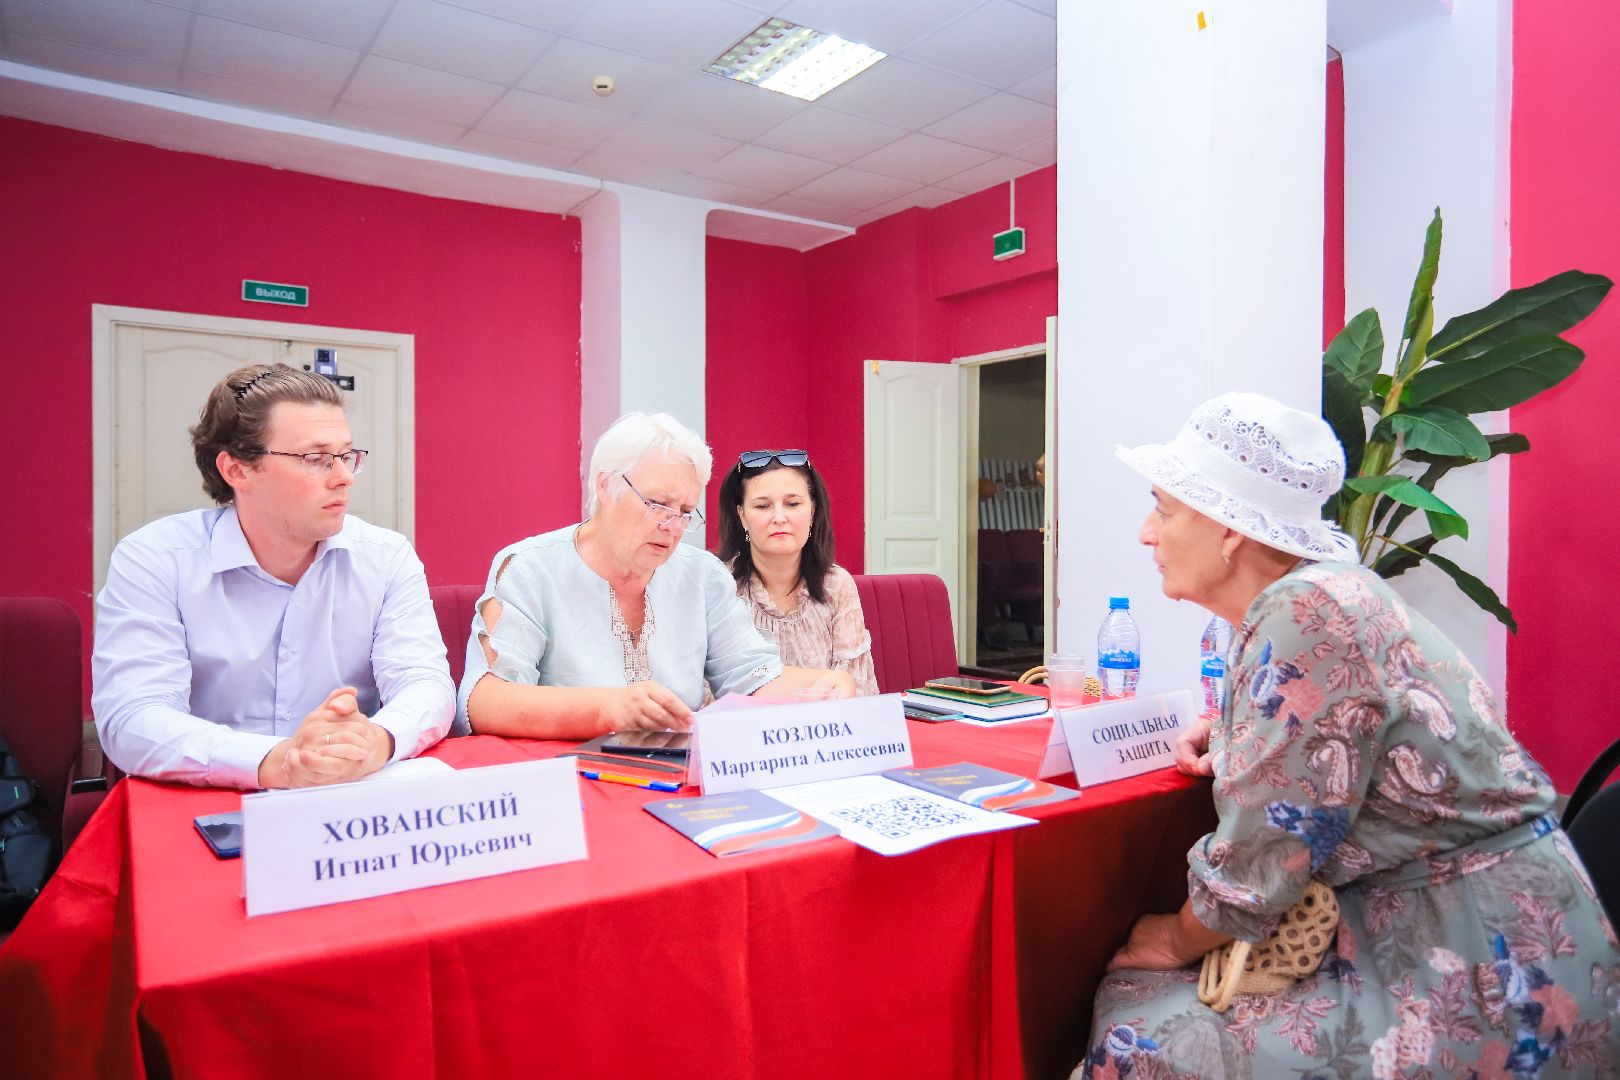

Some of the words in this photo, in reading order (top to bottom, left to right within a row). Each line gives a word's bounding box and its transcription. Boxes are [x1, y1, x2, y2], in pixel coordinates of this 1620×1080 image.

[762, 721, 853, 746] КОЗЛОВА
[1092, 713, 1180, 745] СОЦИАЛЬНАЯ
[710, 752, 809, 778] Маргарита
[814, 741, 906, 764] Алексеевна
[1116, 740, 1172, 764] ЗАЩИТА
[322, 791, 519, 845] ХОВАНСКИЙ
[313, 851, 402, 882] Игнат
[410, 832, 533, 867] Юрьевич
